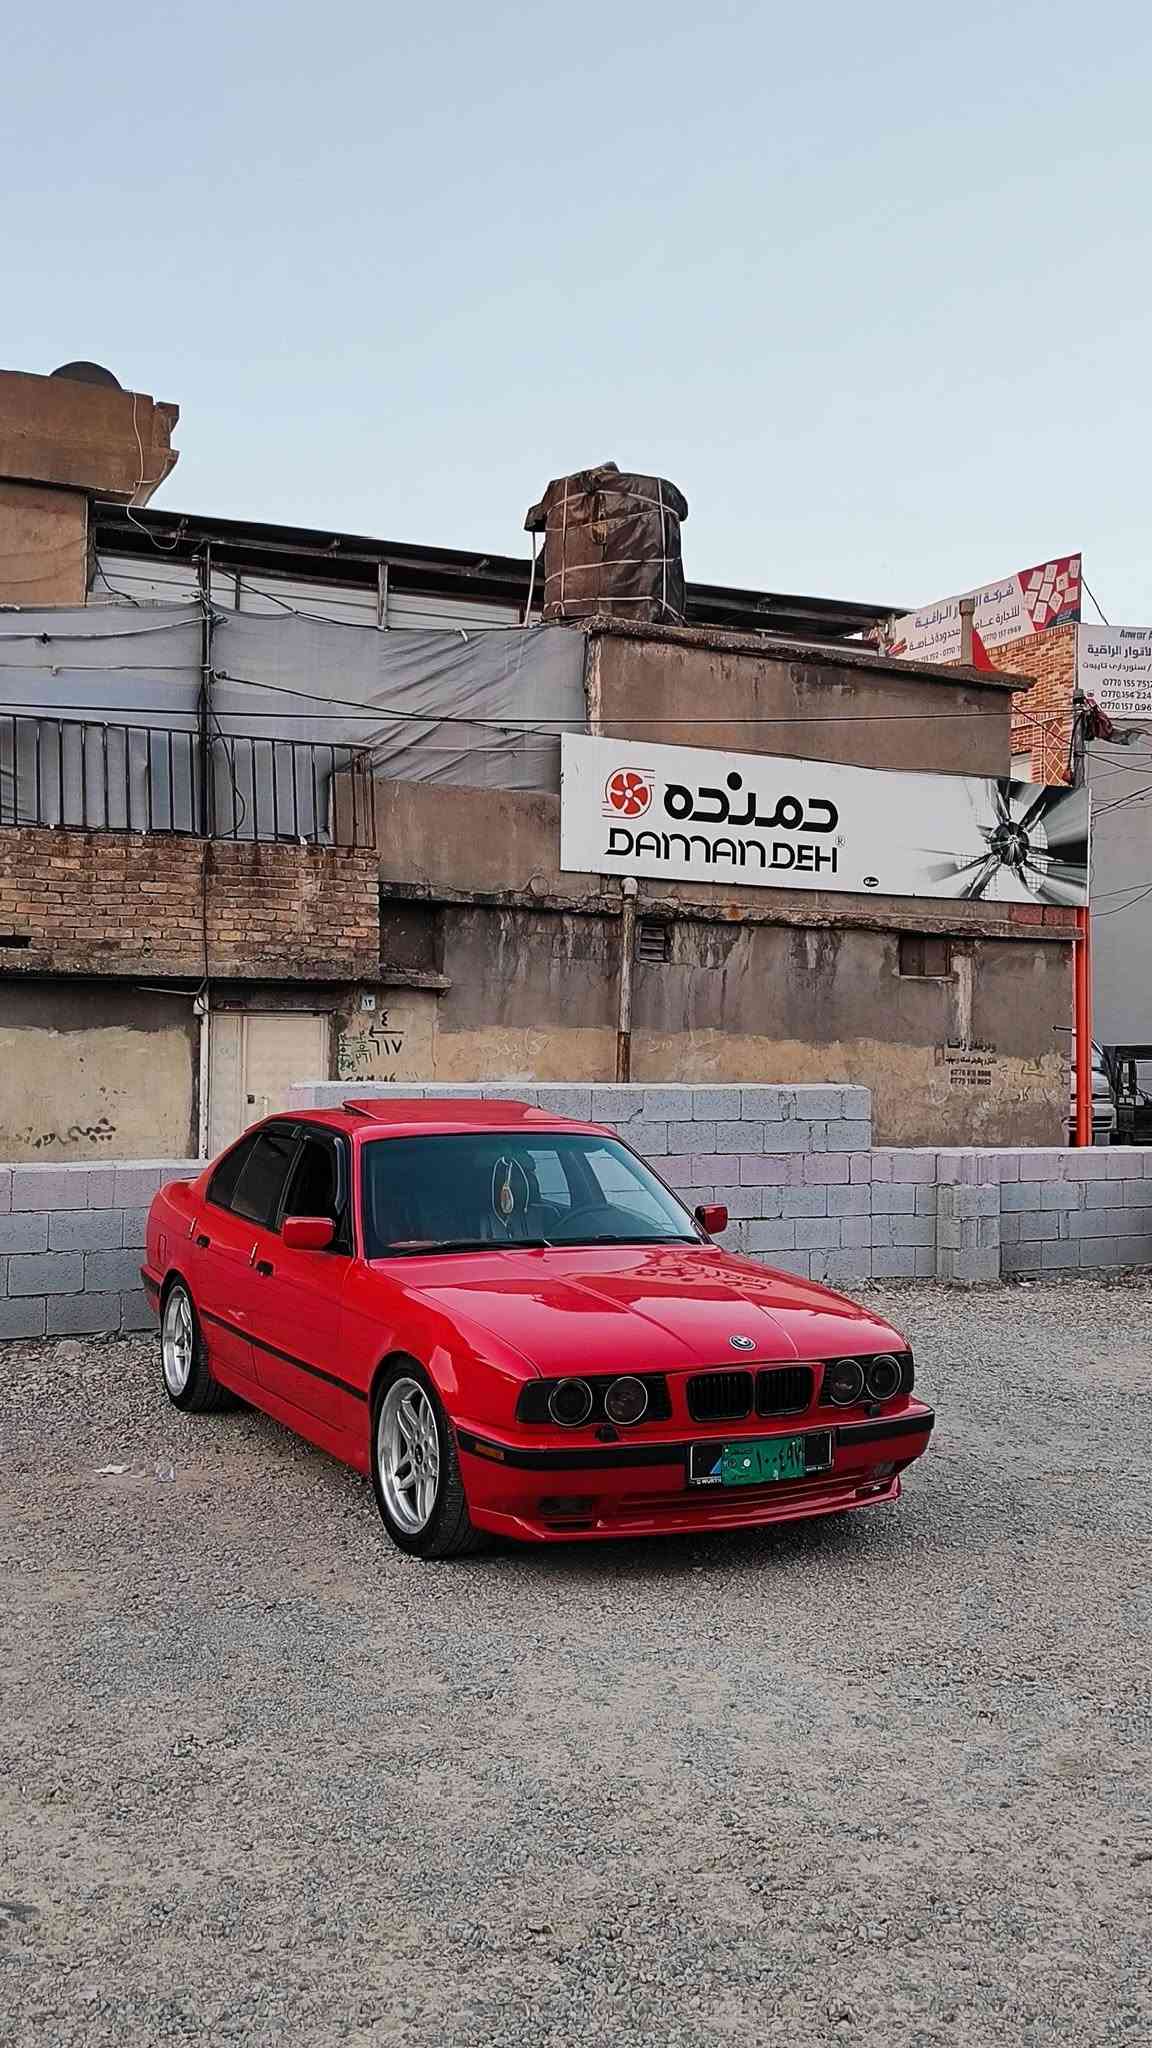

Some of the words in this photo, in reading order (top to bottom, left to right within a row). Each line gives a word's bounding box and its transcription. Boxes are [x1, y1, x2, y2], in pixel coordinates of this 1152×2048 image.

[1101, 690, 1120, 698] 0770
[1102, 679, 1121, 687] 0770
[663, 771, 839, 833] دمنده
[603, 826, 838, 874] DAMANDEH
